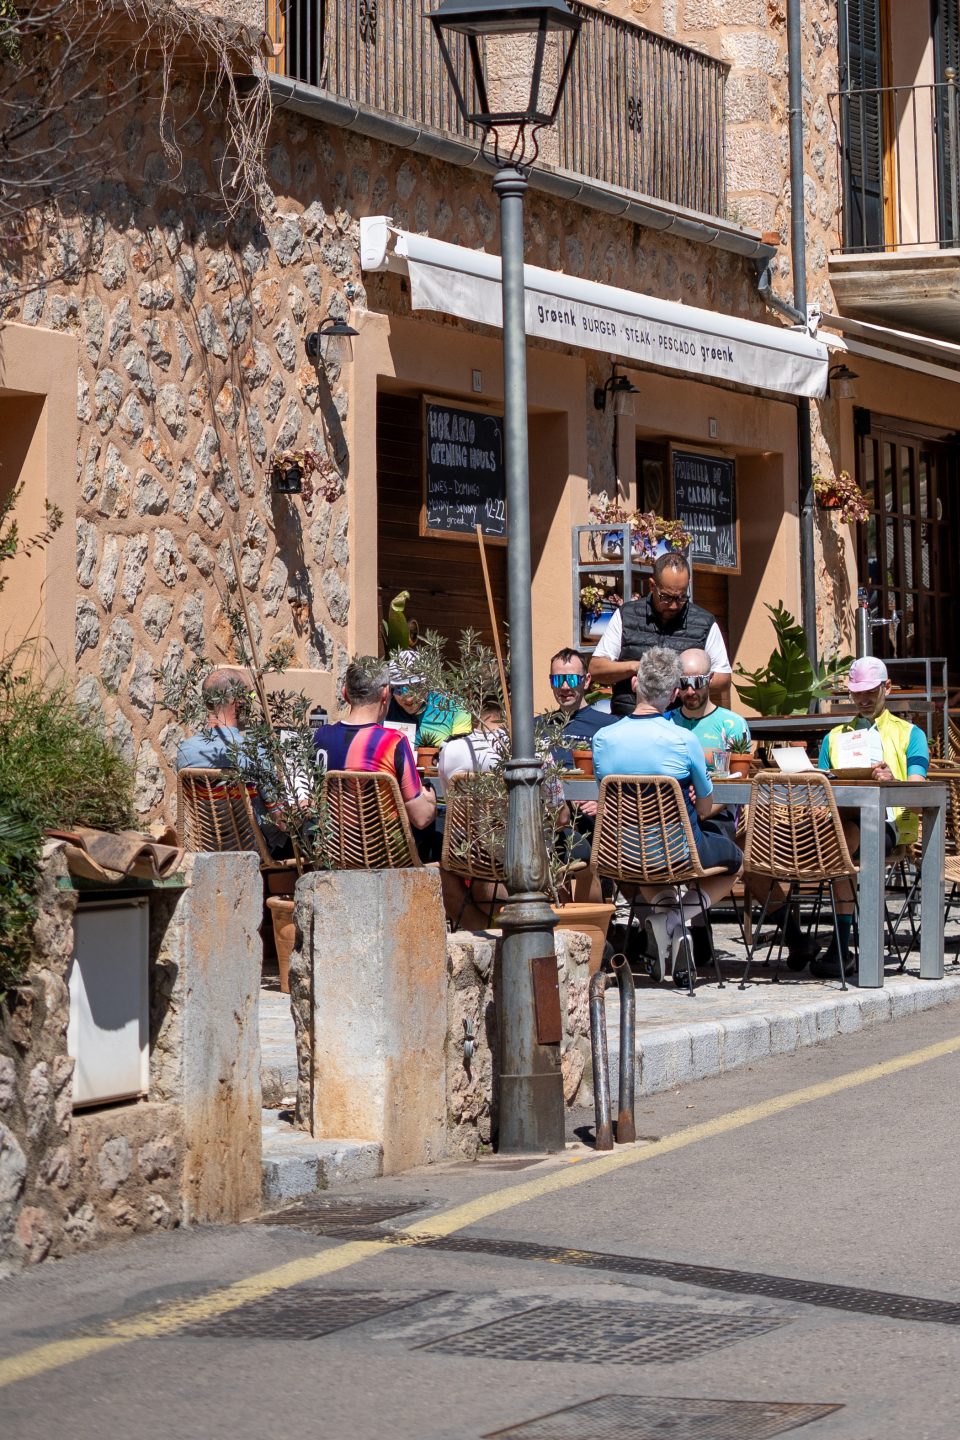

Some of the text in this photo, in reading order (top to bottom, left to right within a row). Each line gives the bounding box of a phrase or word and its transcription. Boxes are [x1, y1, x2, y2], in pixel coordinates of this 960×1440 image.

[582, 316, 616, 337] BURGER
[625, 328, 651, 346] STEAK
[658, 334, 696, 357] PESCADO
[429, 410, 476, 444] HORARIO
[430, 442, 497, 472] OPENING HOURS
